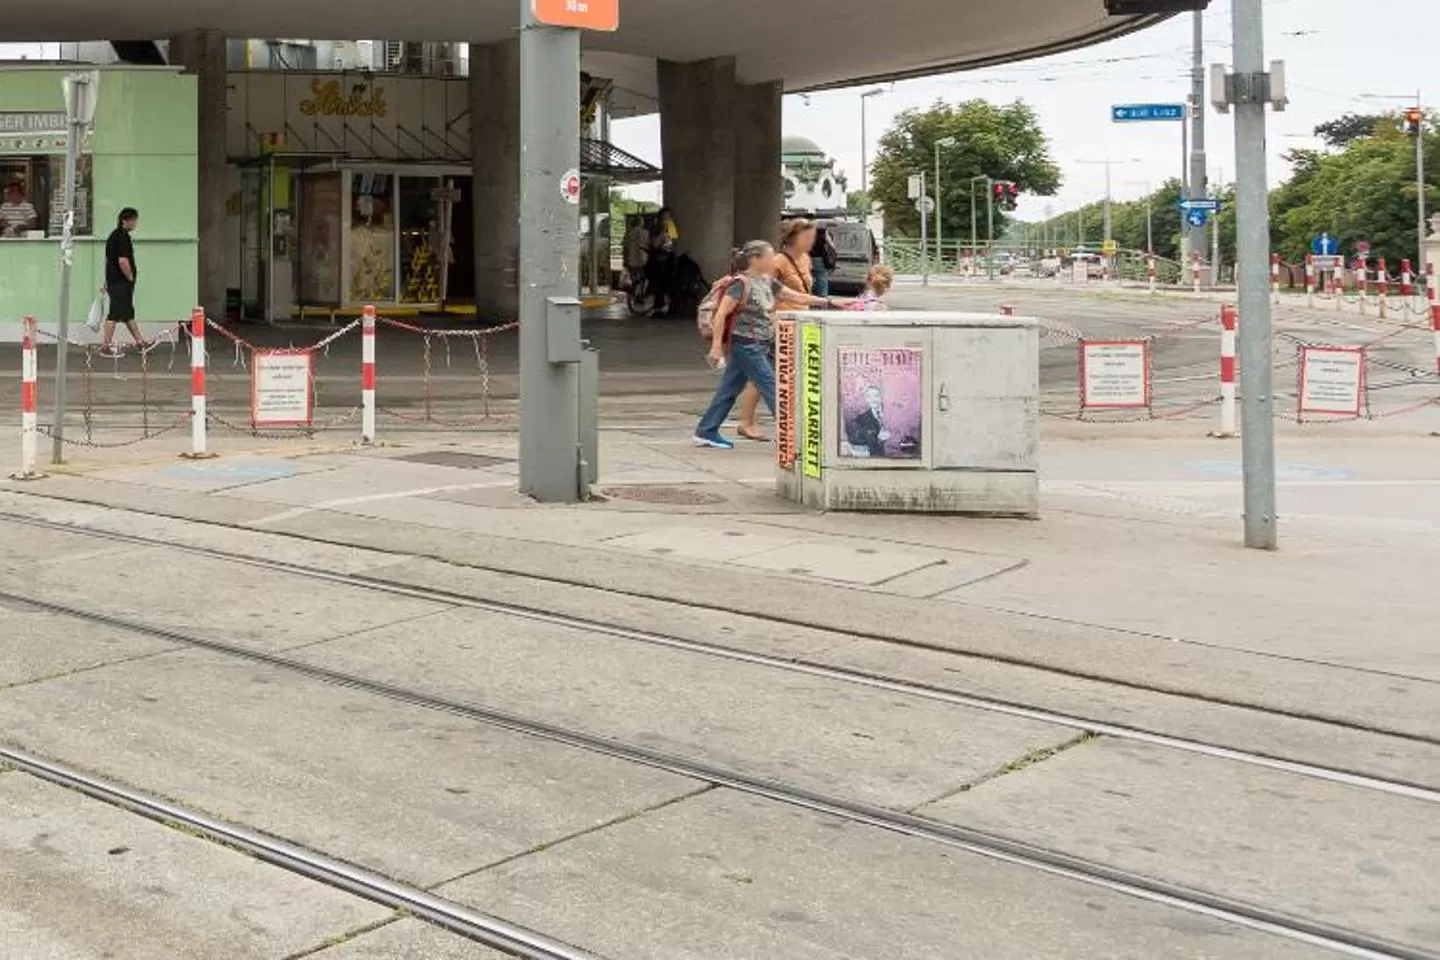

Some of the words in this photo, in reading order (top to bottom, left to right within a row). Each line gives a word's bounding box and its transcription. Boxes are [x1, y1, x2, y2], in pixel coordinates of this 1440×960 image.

[28, 114, 69, 129] IMBI
[778, 324, 789, 385] PALACE
[807, 342, 820, 394] KEITH
[807, 397, 820, 469] JARRETT
